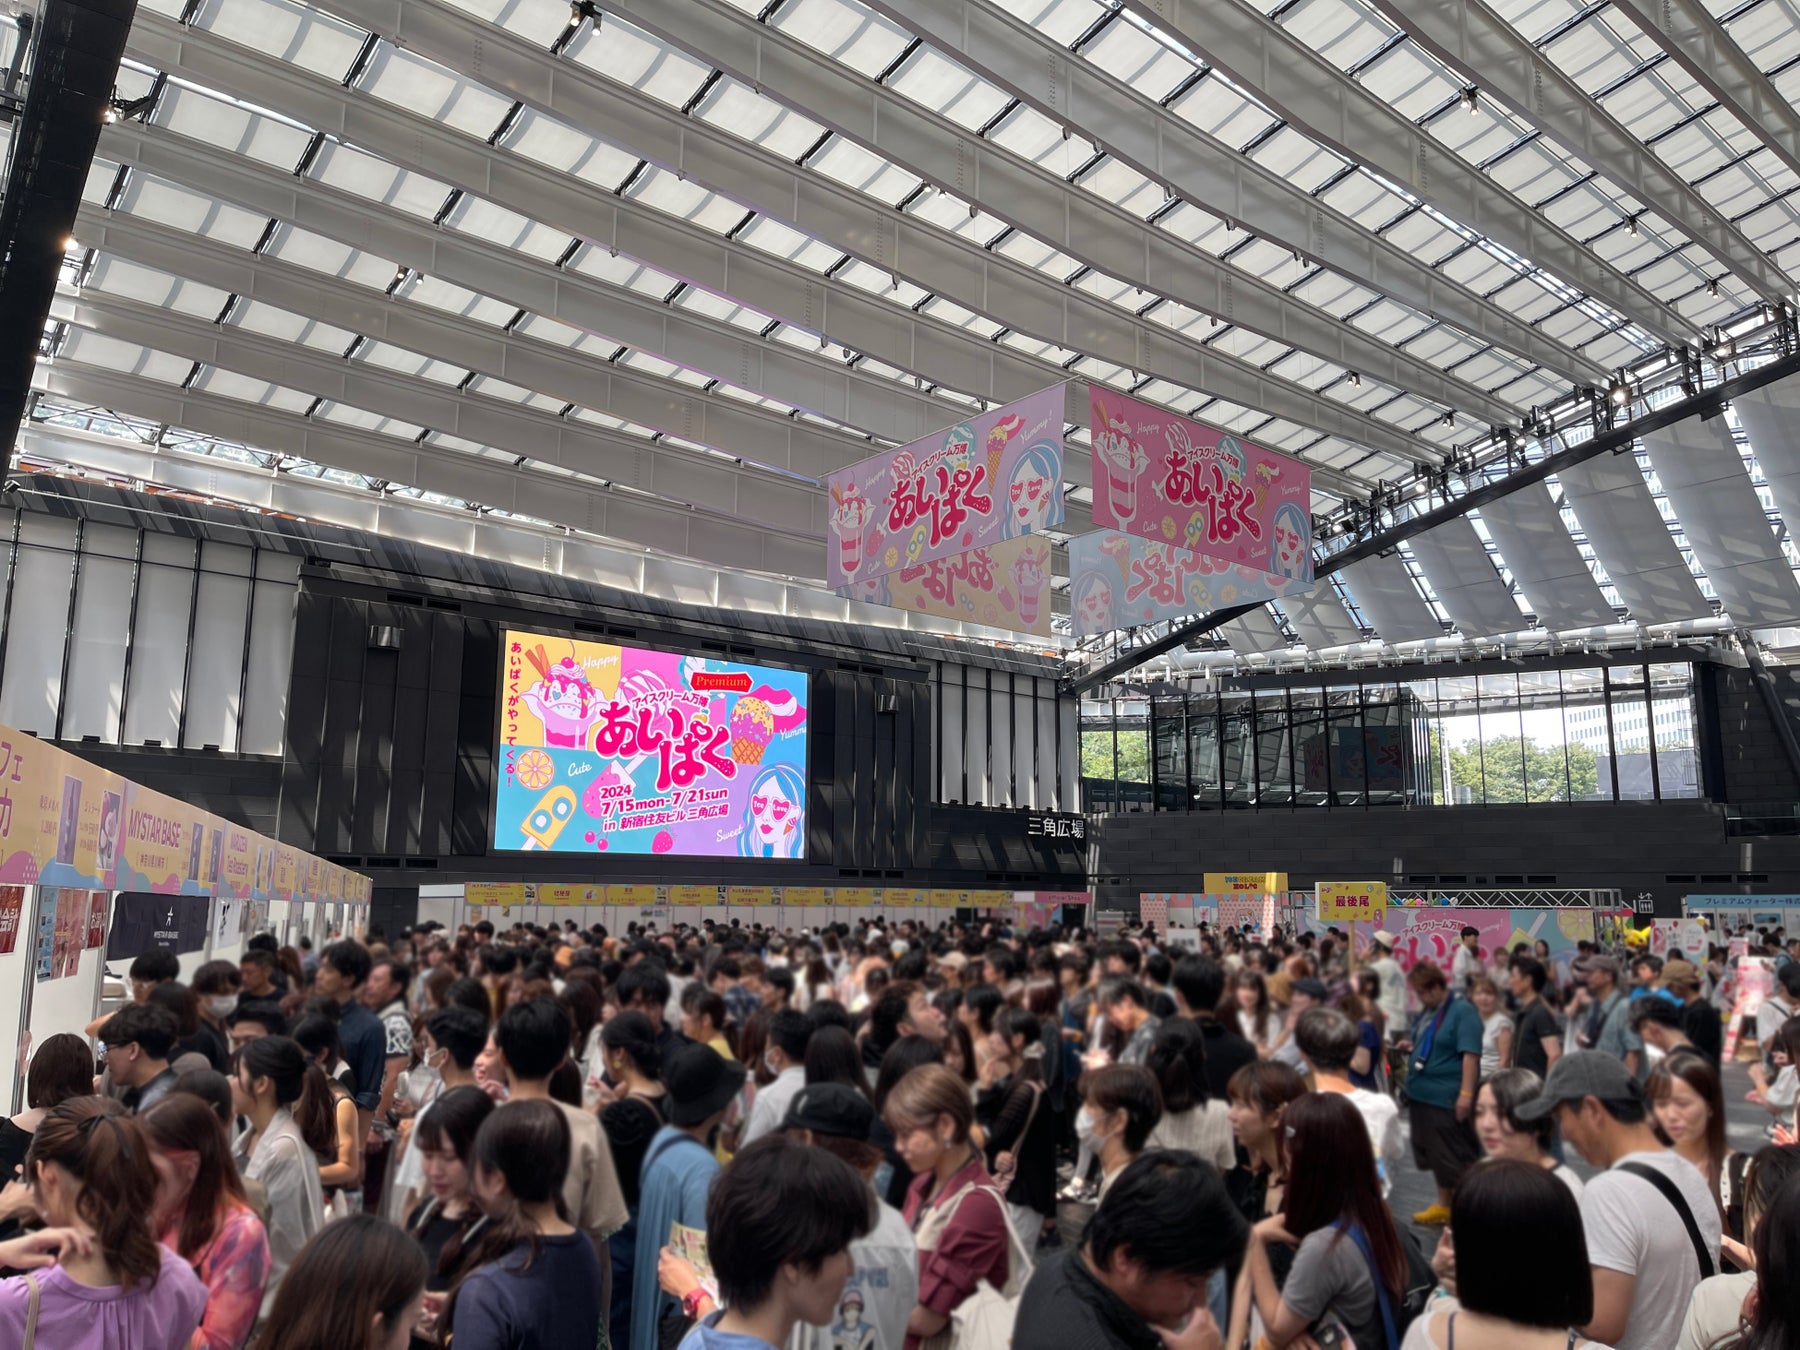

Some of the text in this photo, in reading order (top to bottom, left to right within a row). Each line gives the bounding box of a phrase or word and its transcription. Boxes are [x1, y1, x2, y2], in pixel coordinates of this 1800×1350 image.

[1137, 422, 1160, 435] Happy
[911, 443, 968, 478] アイスクリーム万博
[1188, 447, 1240, 469] アイスクリーム万博
[1165, 451, 1261, 541] あいぱく
[888, 465, 992, 547] あいぱく
[582, 654, 619, 669] Happy
[696, 675, 748, 687] Premium
[632, 690, 709, 709] アイスクリーム万博
[596, 701, 737, 791] あいぱく
[568, 762, 592, 777] Cute
[601, 785, 632, 799] 2024
[753, 800, 788, 813] Ice Love
[161, 820, 181, 848] BASE
[604, 822, 616, 831] in
[716, 824, 744, 842] Sweet
[1028, 817, 1084, 838] 三角広場
[1335, 895, 1370, 907] 最後尾
